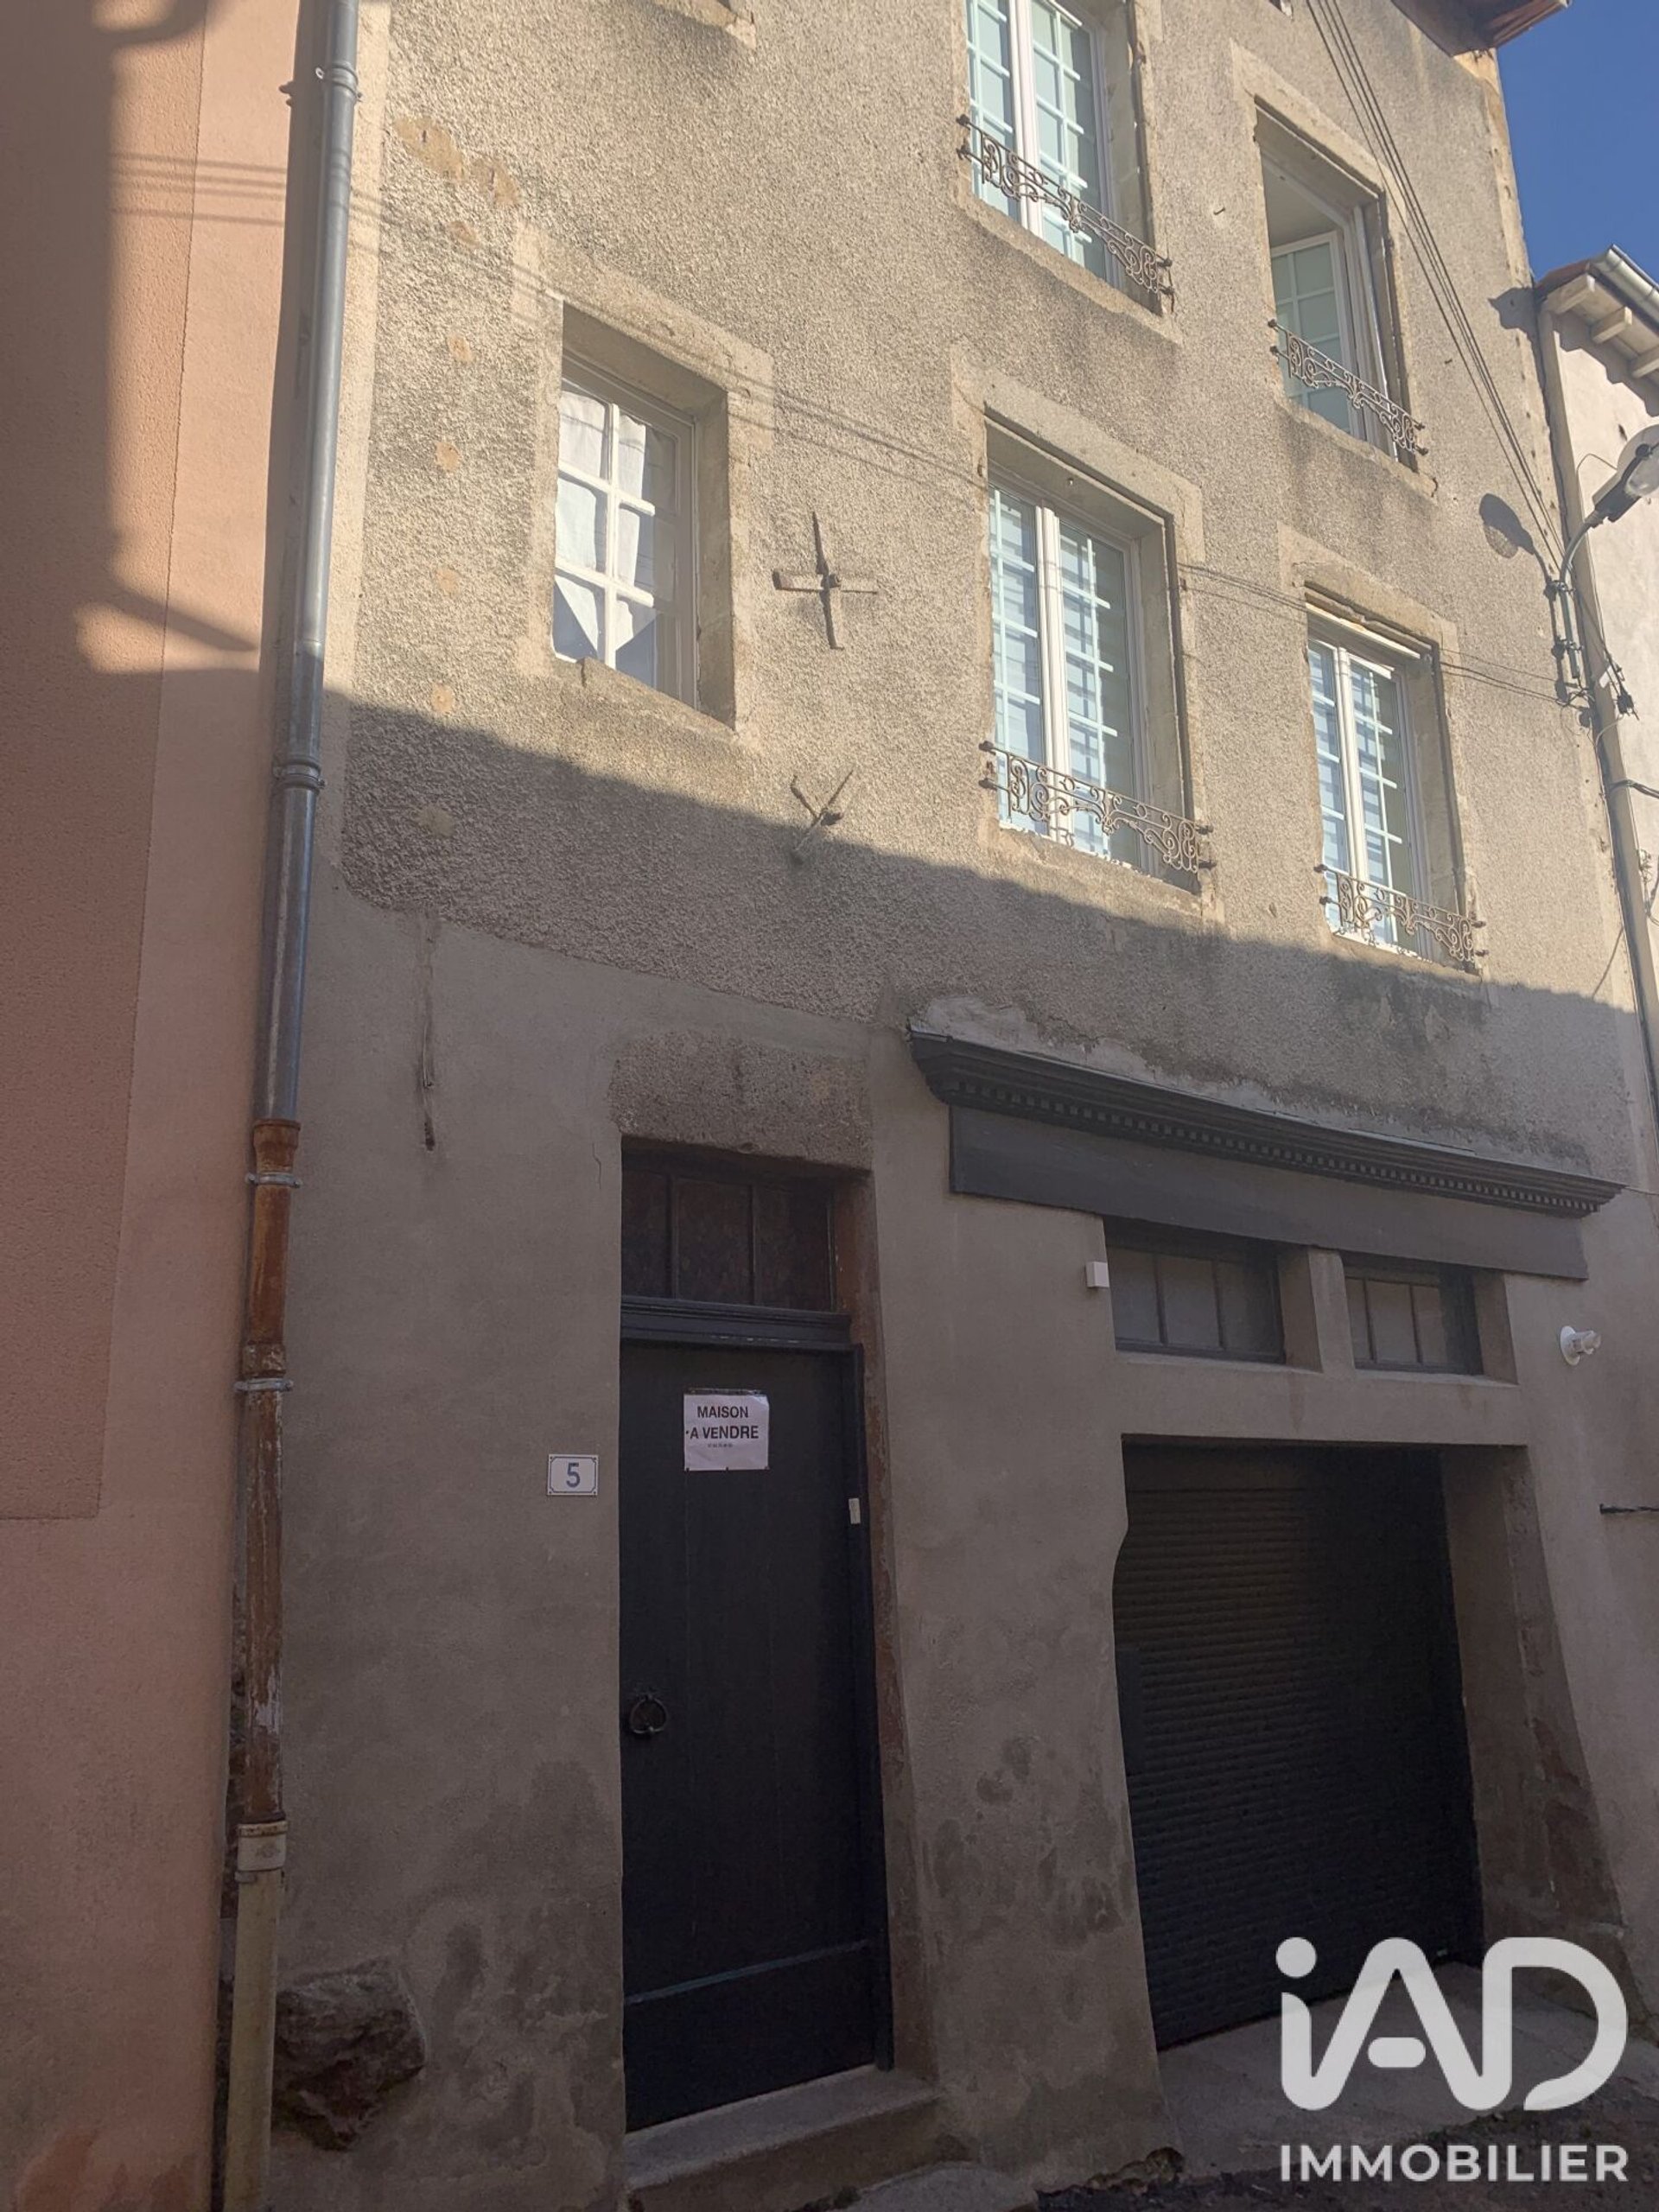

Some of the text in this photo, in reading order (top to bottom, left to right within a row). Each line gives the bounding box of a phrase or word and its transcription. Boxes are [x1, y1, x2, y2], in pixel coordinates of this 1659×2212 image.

[696, 1406, 749, 1418] MAISON
[690, 1426, 759, 1440] A VENDRE
[566, 1462, 581, 1488] 5
